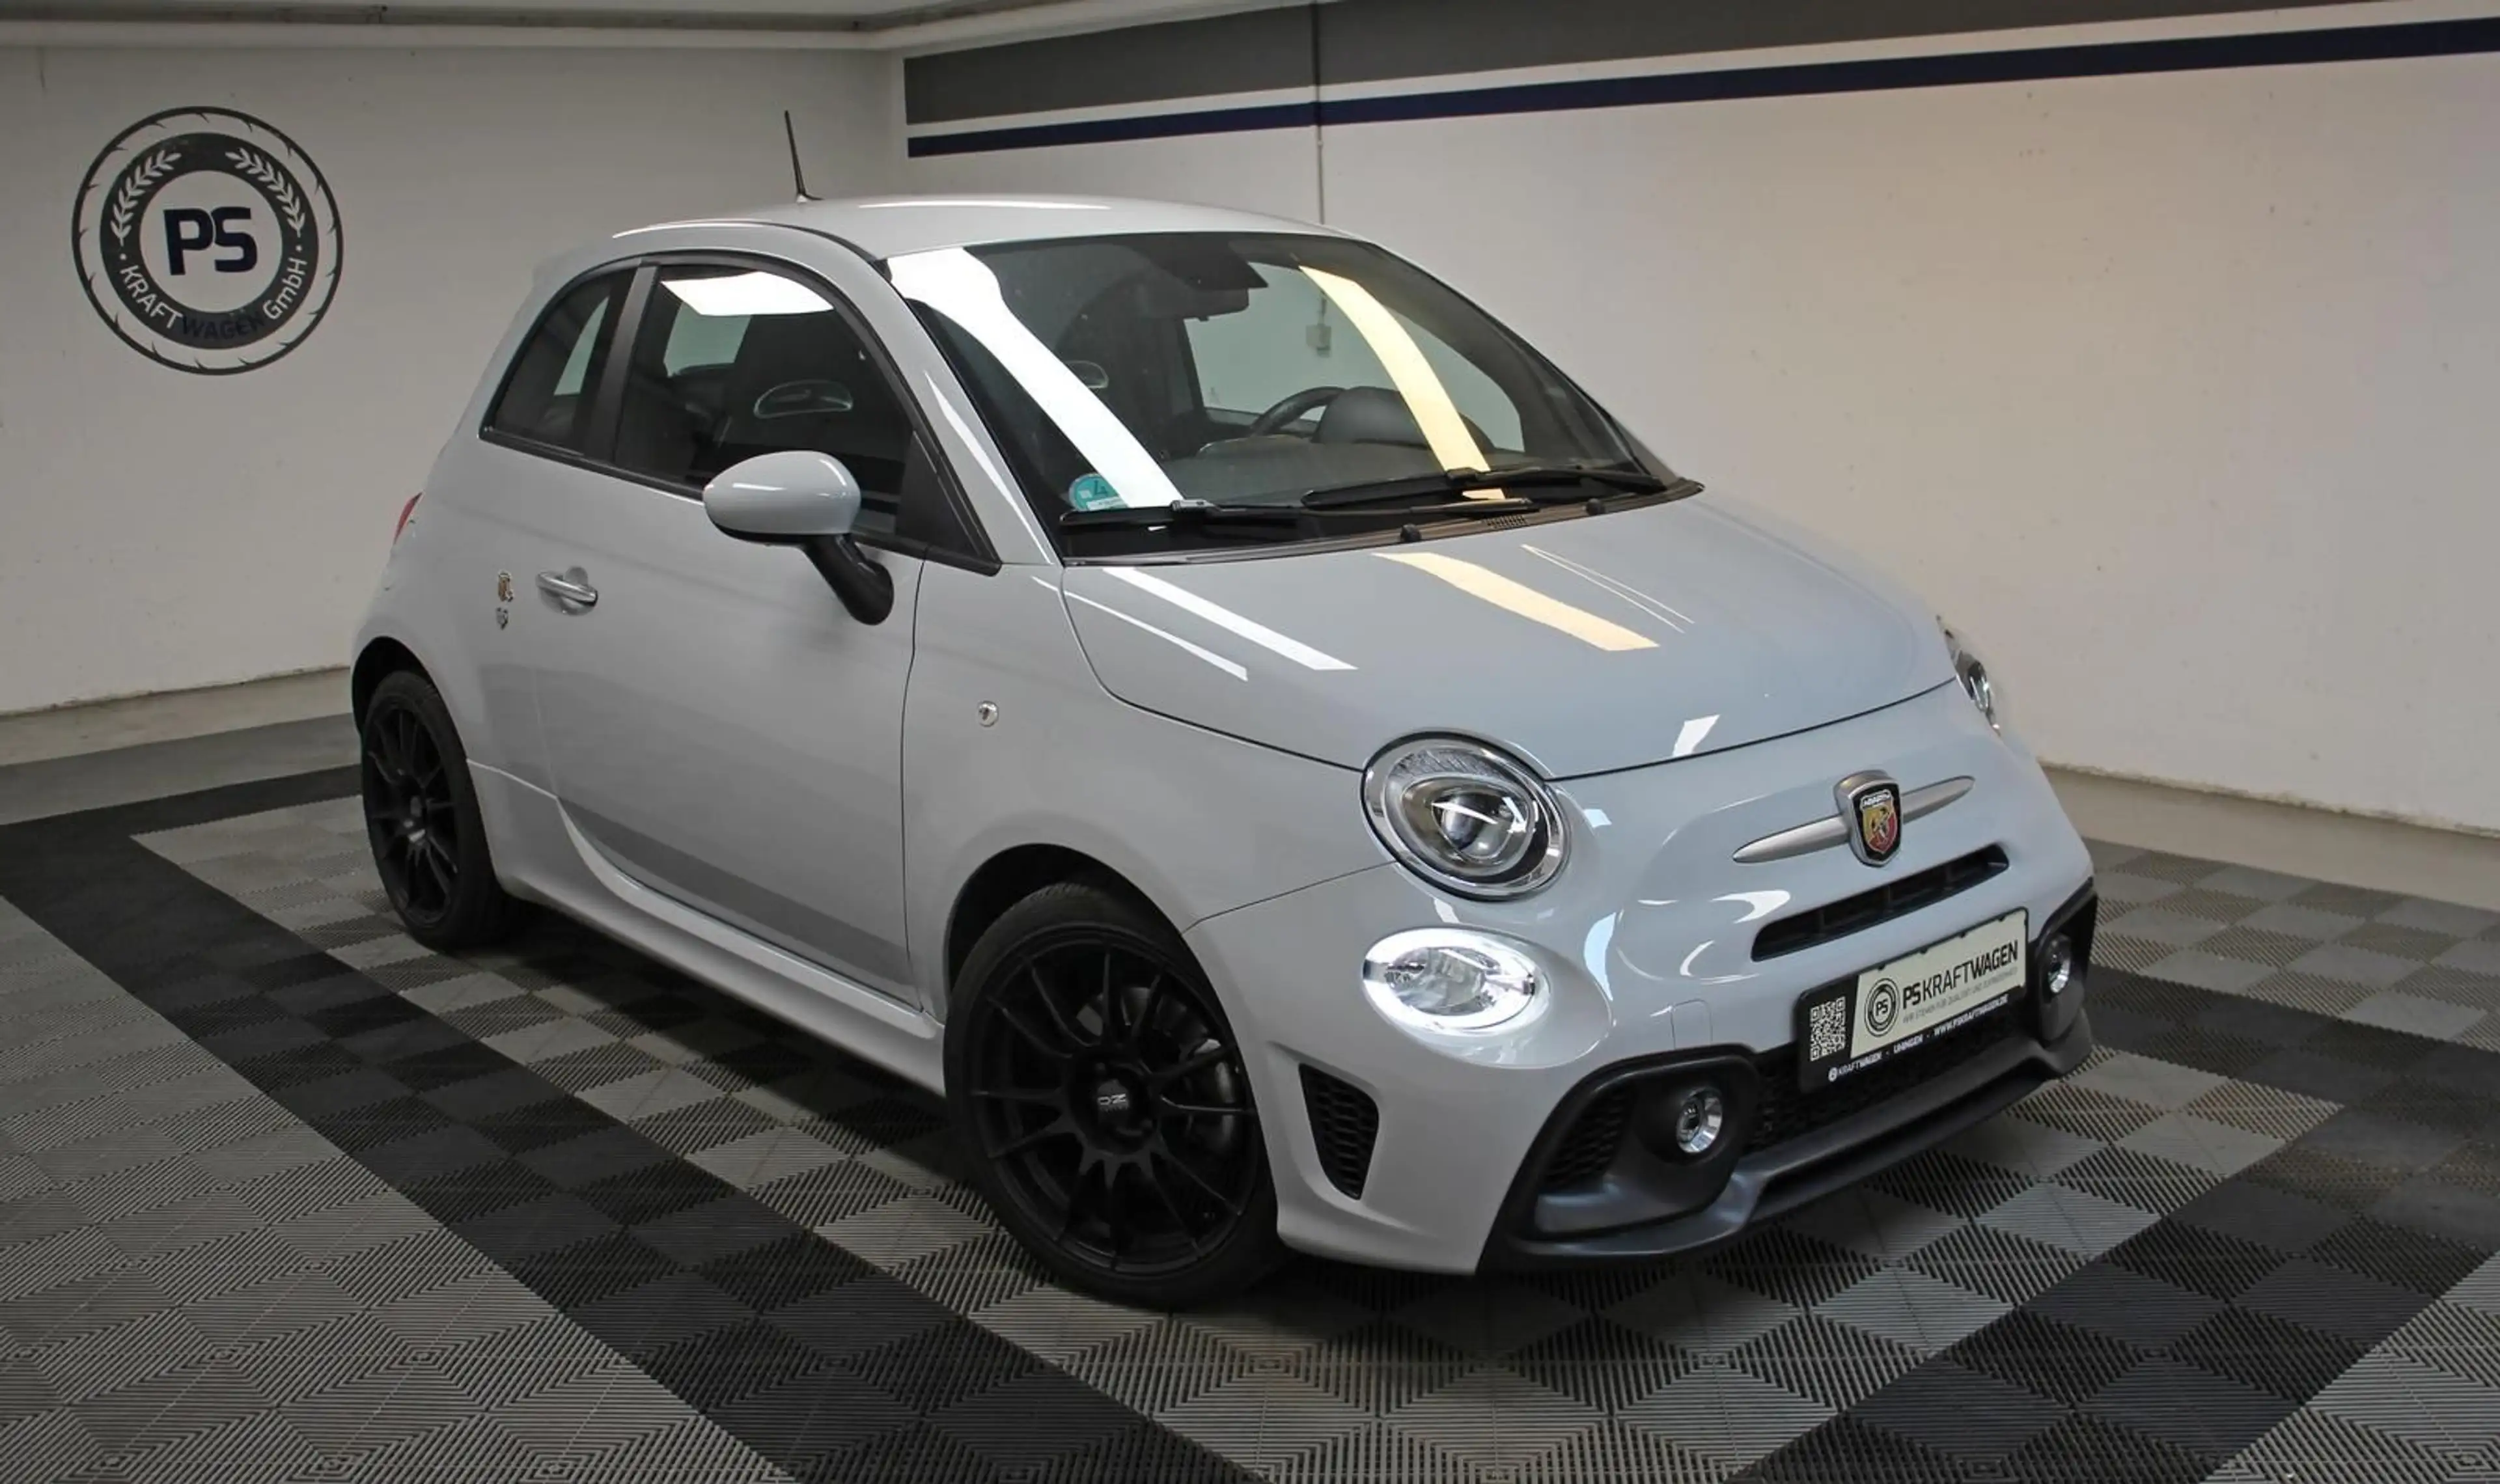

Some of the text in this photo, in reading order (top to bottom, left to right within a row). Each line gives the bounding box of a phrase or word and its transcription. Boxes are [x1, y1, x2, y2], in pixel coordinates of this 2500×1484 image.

[163, 206, 258, 276] PS
[262, 257, 307, 320] GmbH
[1876, 998, 1889, 1017] PS
